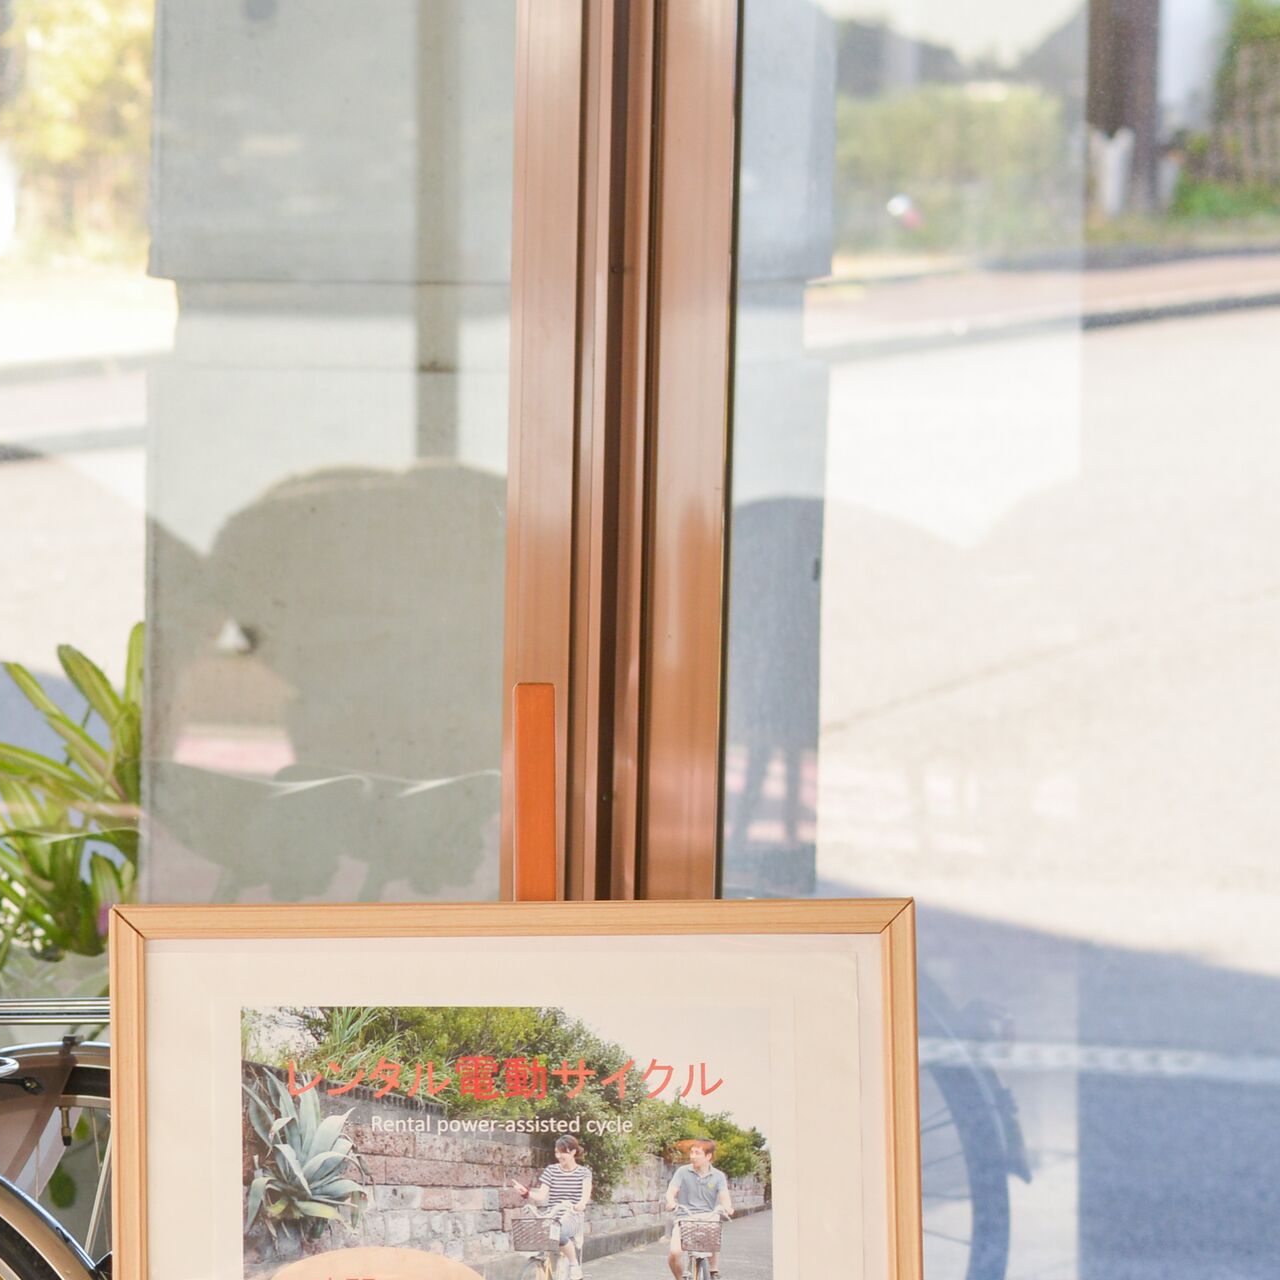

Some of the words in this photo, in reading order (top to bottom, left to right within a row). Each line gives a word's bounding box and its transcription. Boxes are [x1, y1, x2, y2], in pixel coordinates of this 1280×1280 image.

[286, 1055, 724, 1101] レンタル電動サイクル
[371, 1115, 432, 1134] Rental
[437, 1115, 581, 1137] power-assisted
[585, 1116, 634, 1137] cycle
